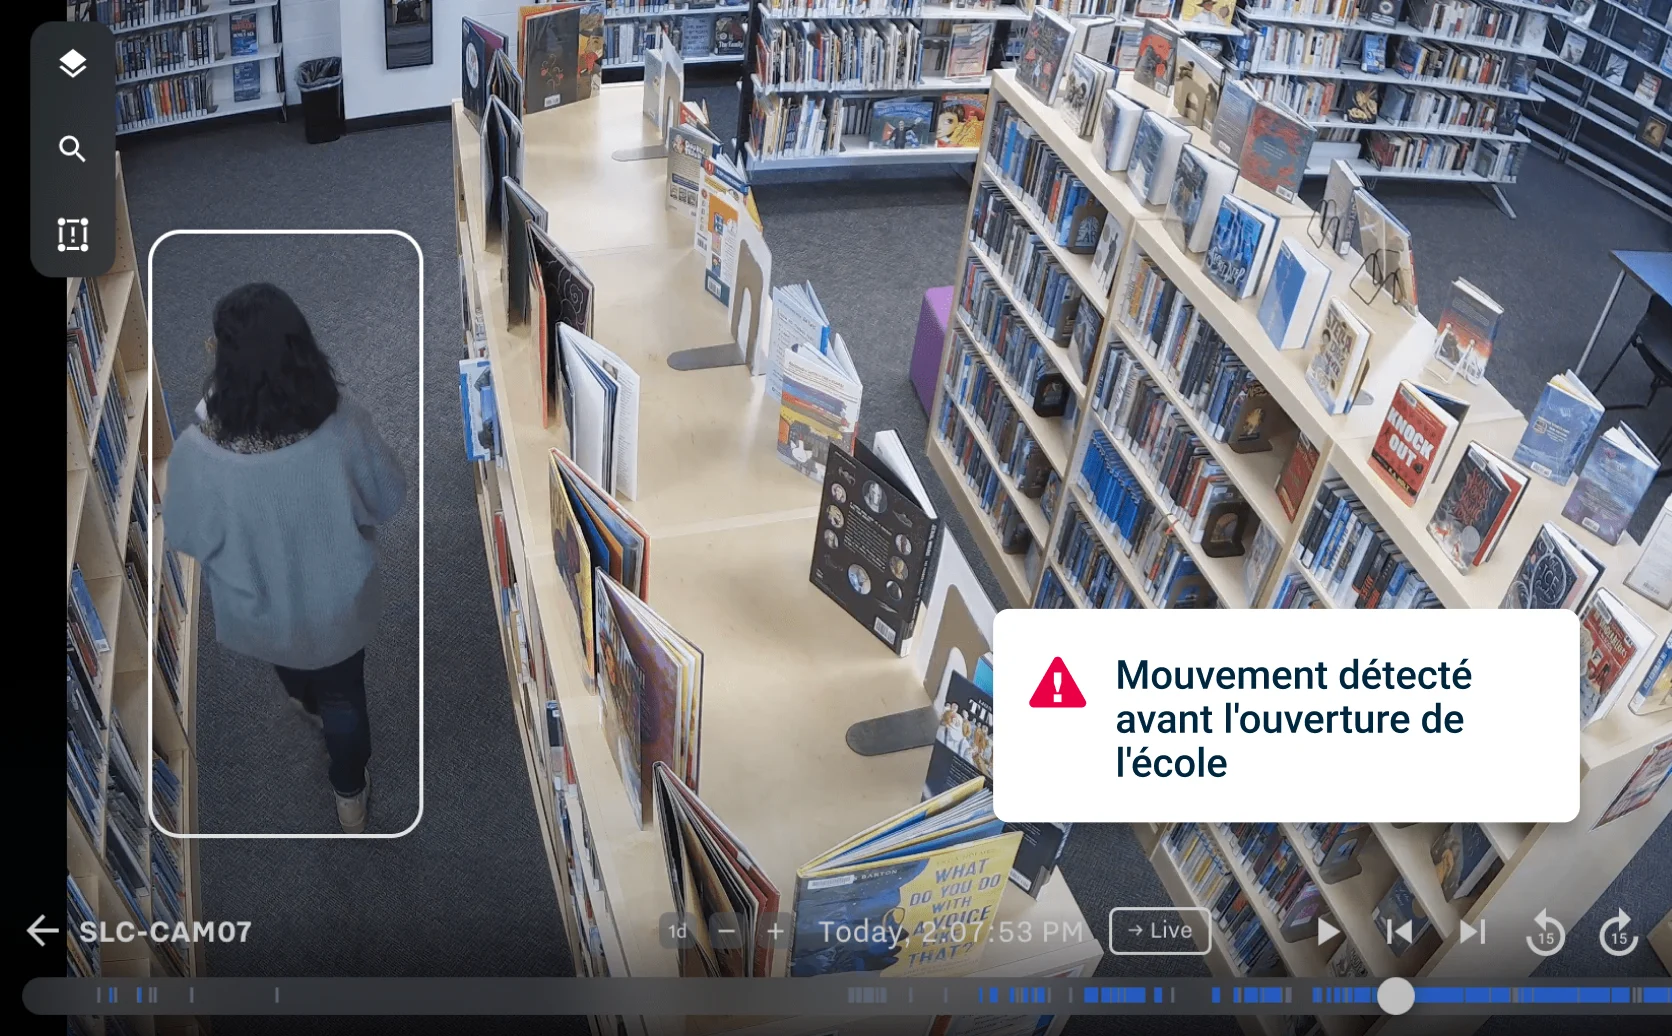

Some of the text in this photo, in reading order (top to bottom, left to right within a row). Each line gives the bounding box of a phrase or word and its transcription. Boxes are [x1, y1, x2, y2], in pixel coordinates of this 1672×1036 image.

[1386, 406, 1435, 461] KNOCK
[1388, 433, 1418, 468] OUT
[861, 869, 898, 880] BARTON
[935, 857, 990, 884] WHAT
[909, 873, 1001, 907] DO YOU DO
[931, 896, 973, 914] WITH
[913, 904, 993, 936] A VOICE
[908, 941, 974, 969] THAT?
